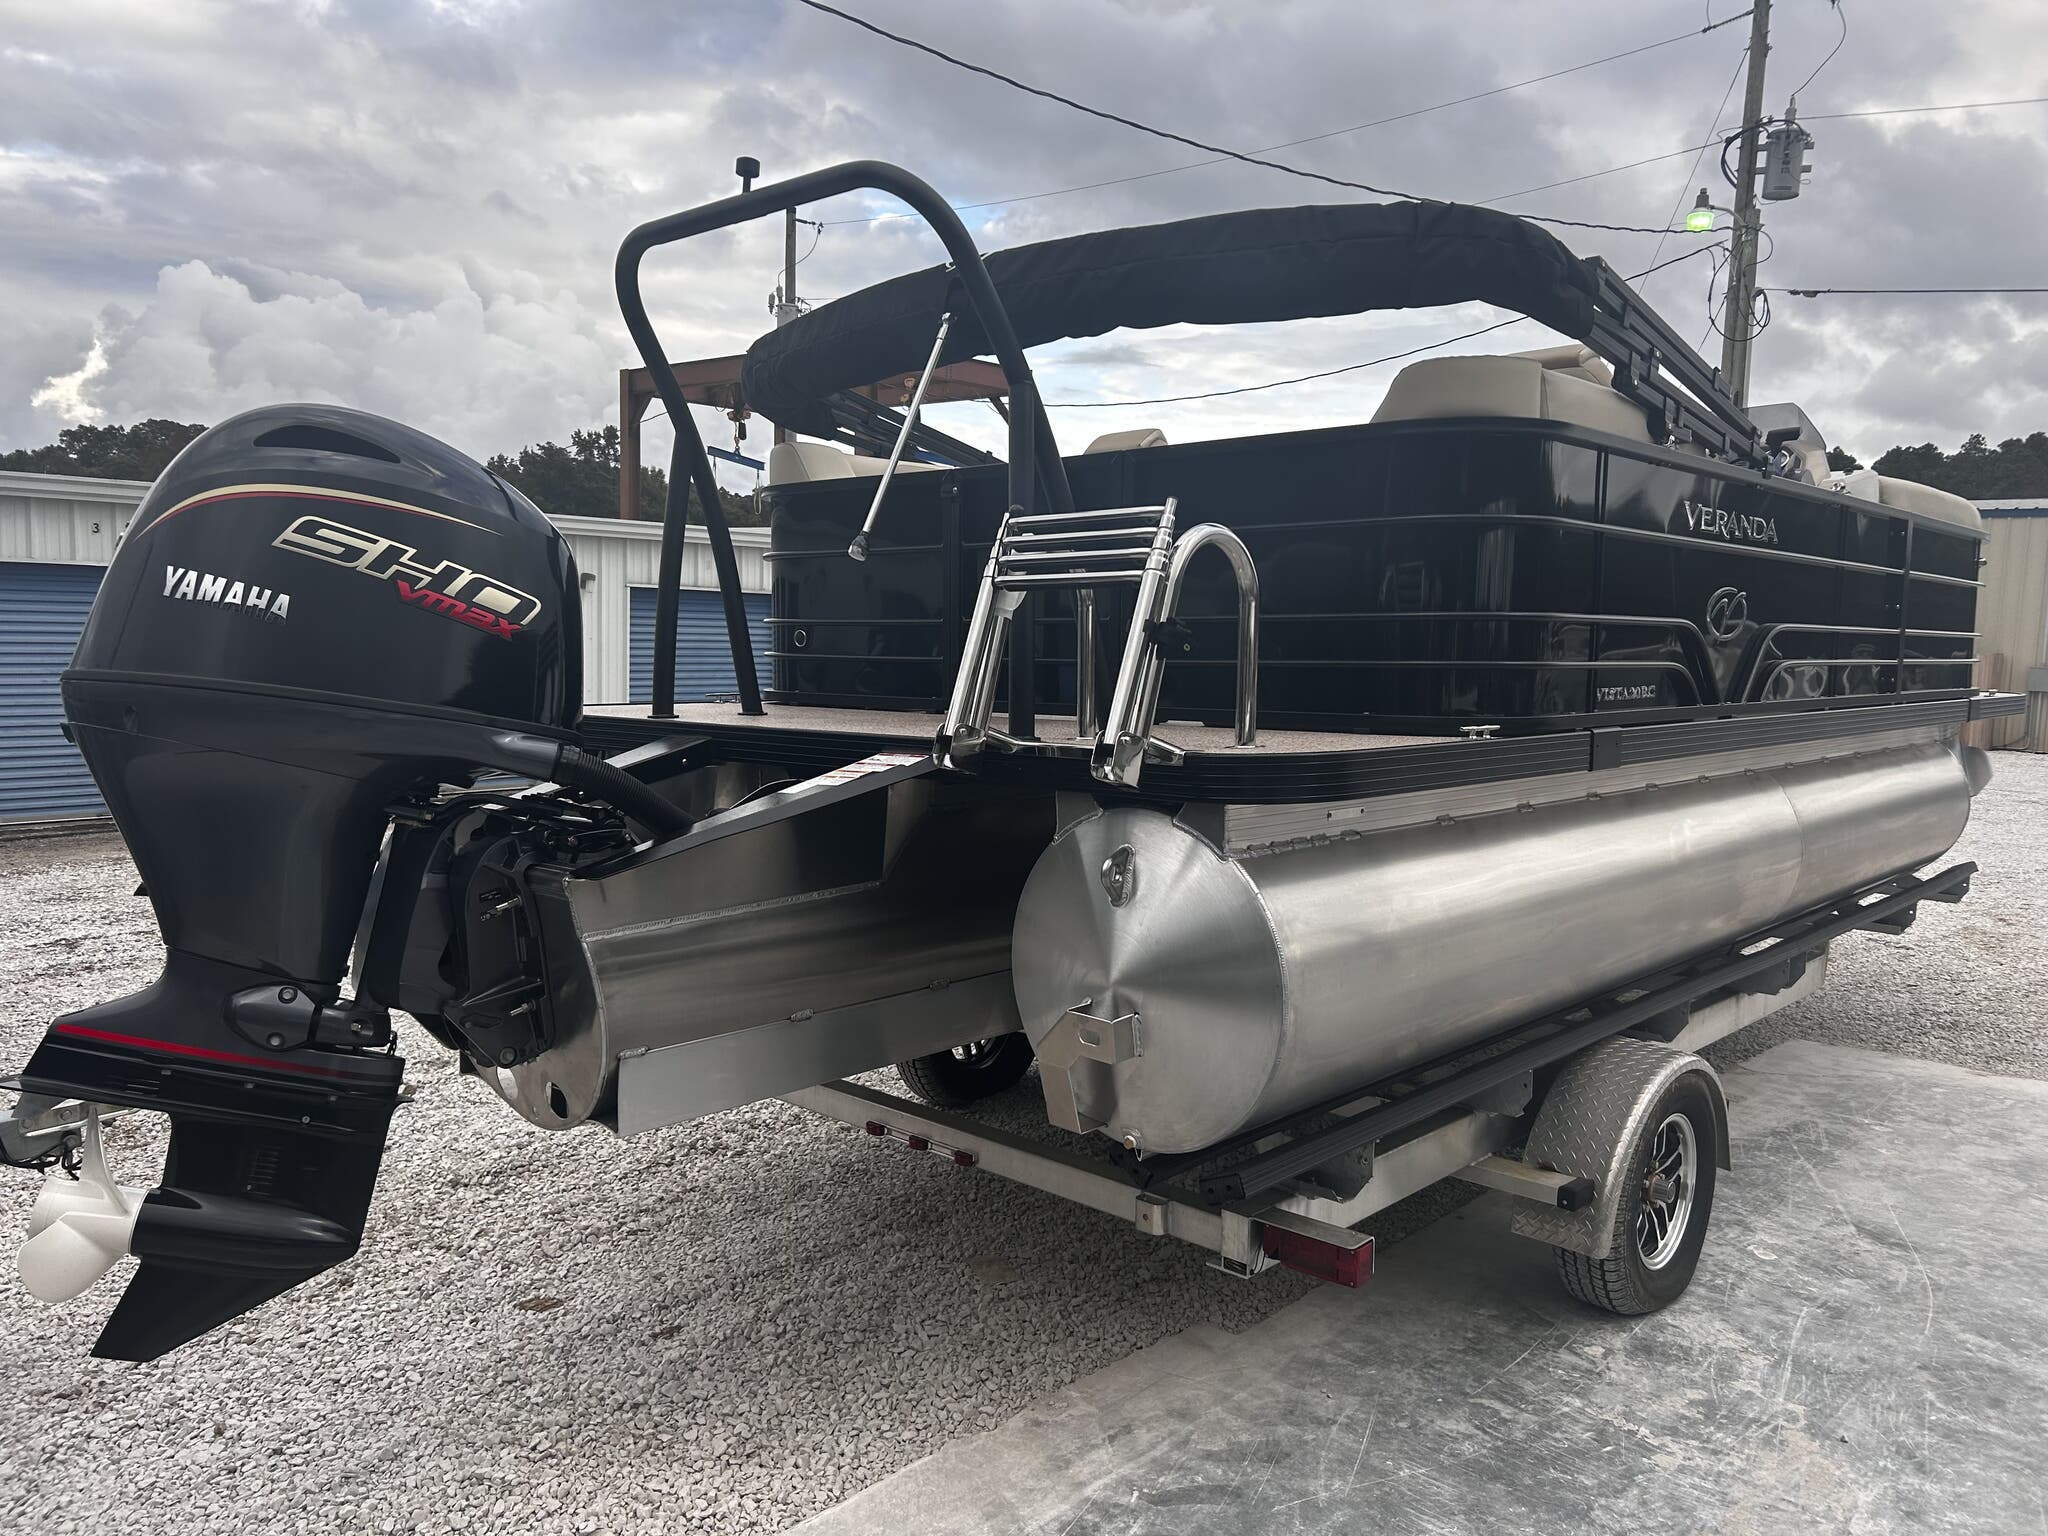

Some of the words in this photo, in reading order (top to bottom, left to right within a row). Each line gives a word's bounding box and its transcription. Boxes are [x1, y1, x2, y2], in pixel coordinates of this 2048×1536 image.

[91, 522, 100, 534] 3
[1683, 500, 1778, 544] VERANDA
[162, 565, 290, 622] YAMAHA
[271, 515, 542, 626] SHO
